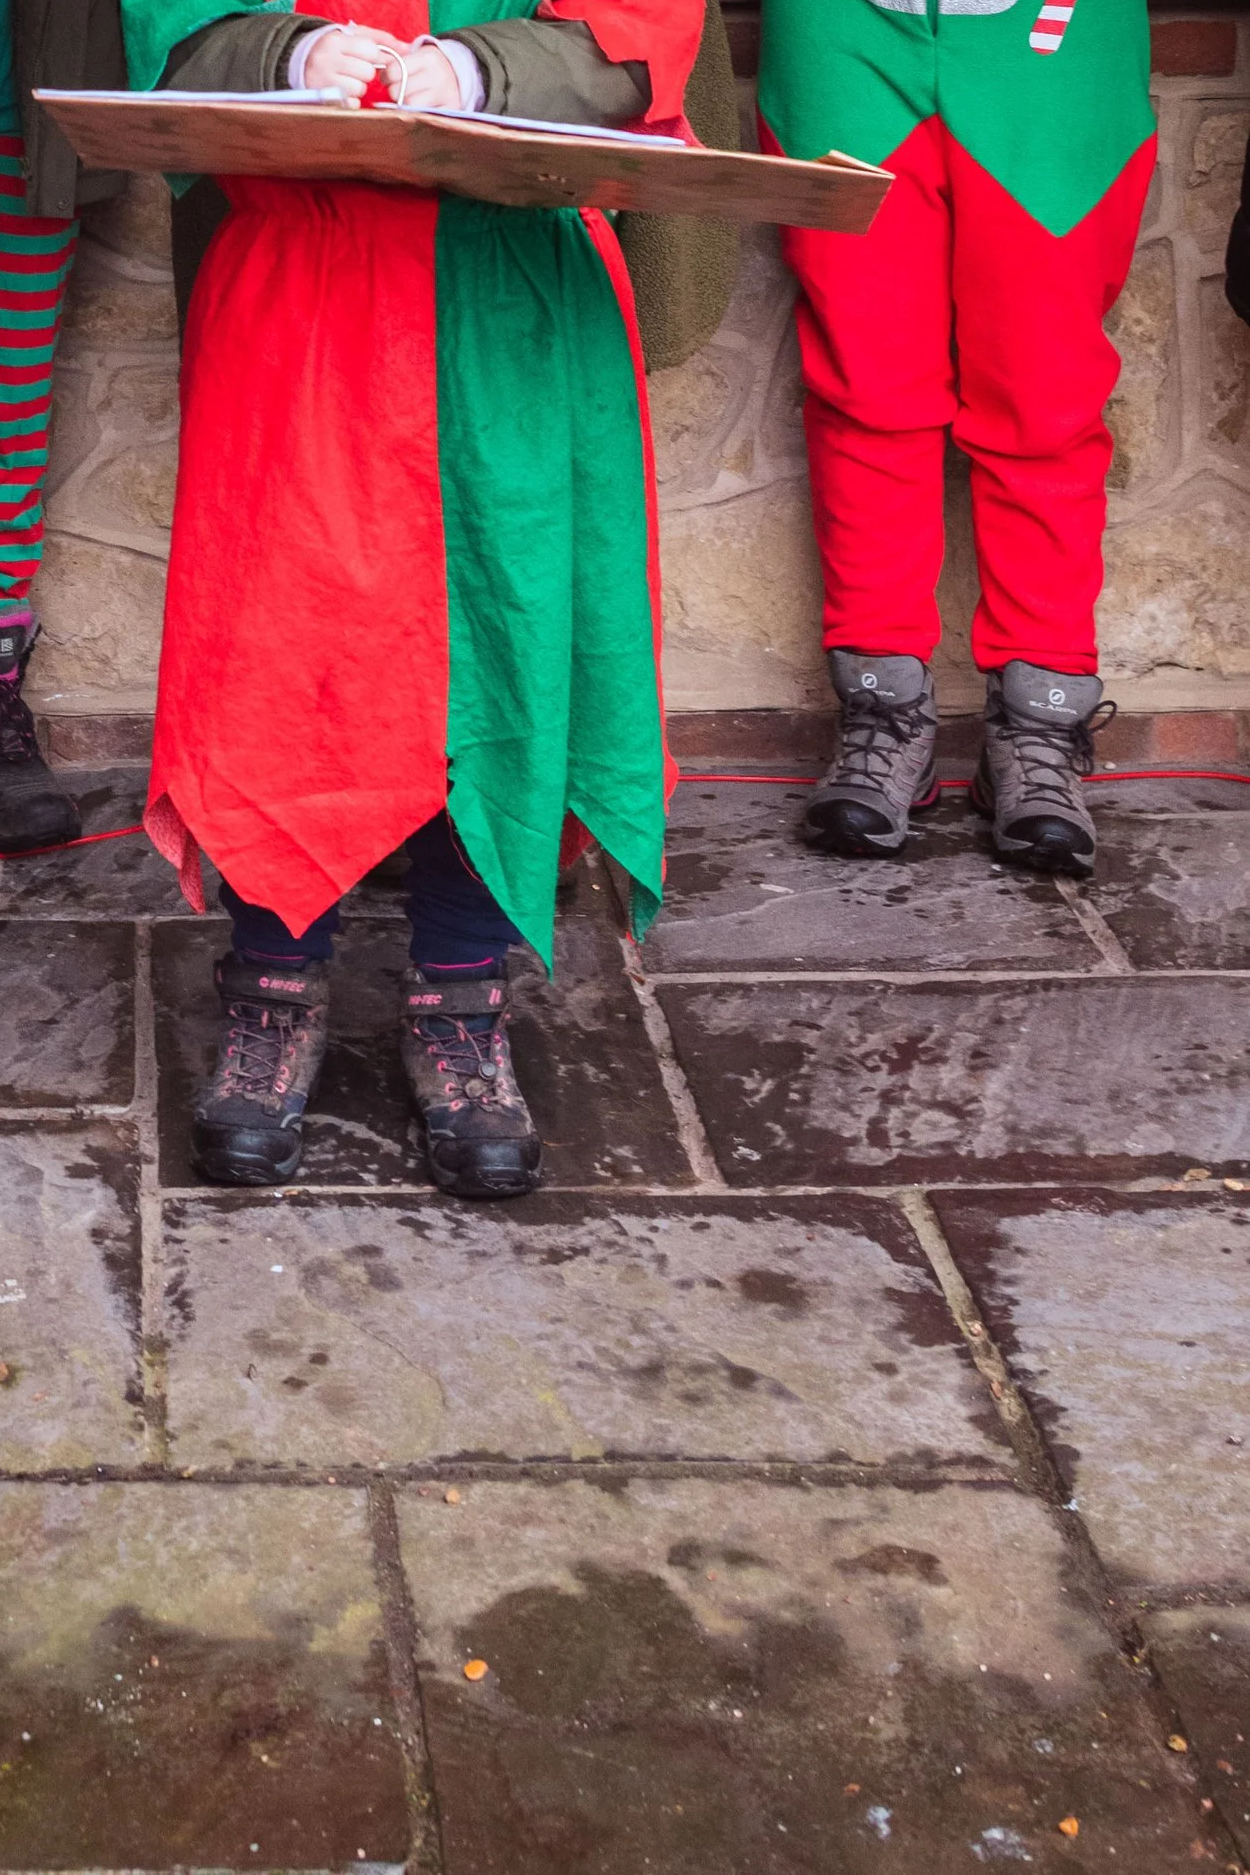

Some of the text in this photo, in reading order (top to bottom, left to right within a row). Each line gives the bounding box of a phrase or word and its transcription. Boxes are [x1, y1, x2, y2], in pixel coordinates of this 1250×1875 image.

[1028, 700, 1079, 716] SCARPA
[269, 978, 308, 993] HI-TEC
[408, 993, 443, 1005] HI-TEC
